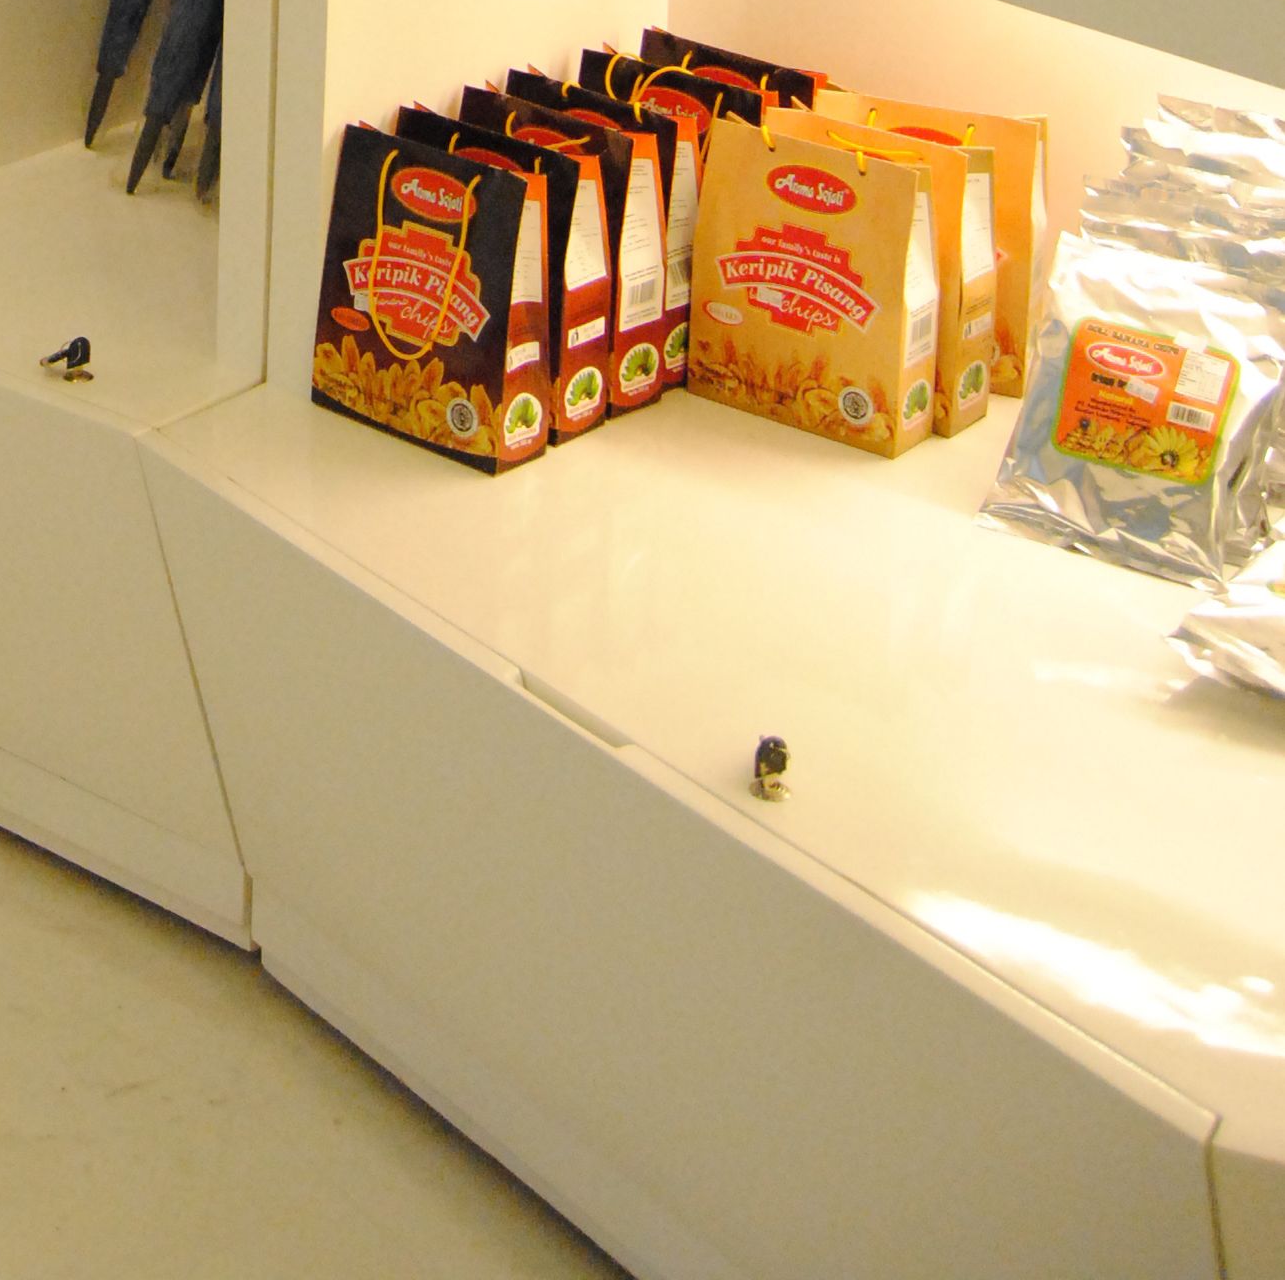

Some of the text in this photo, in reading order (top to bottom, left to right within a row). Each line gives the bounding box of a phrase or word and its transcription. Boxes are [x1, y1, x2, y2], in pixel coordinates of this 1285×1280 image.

[354, 262, 479, 328] Kripik Piang
[725, 258, 867, 320] Keripik Pisang
[781, 294, 837, 332] chips
